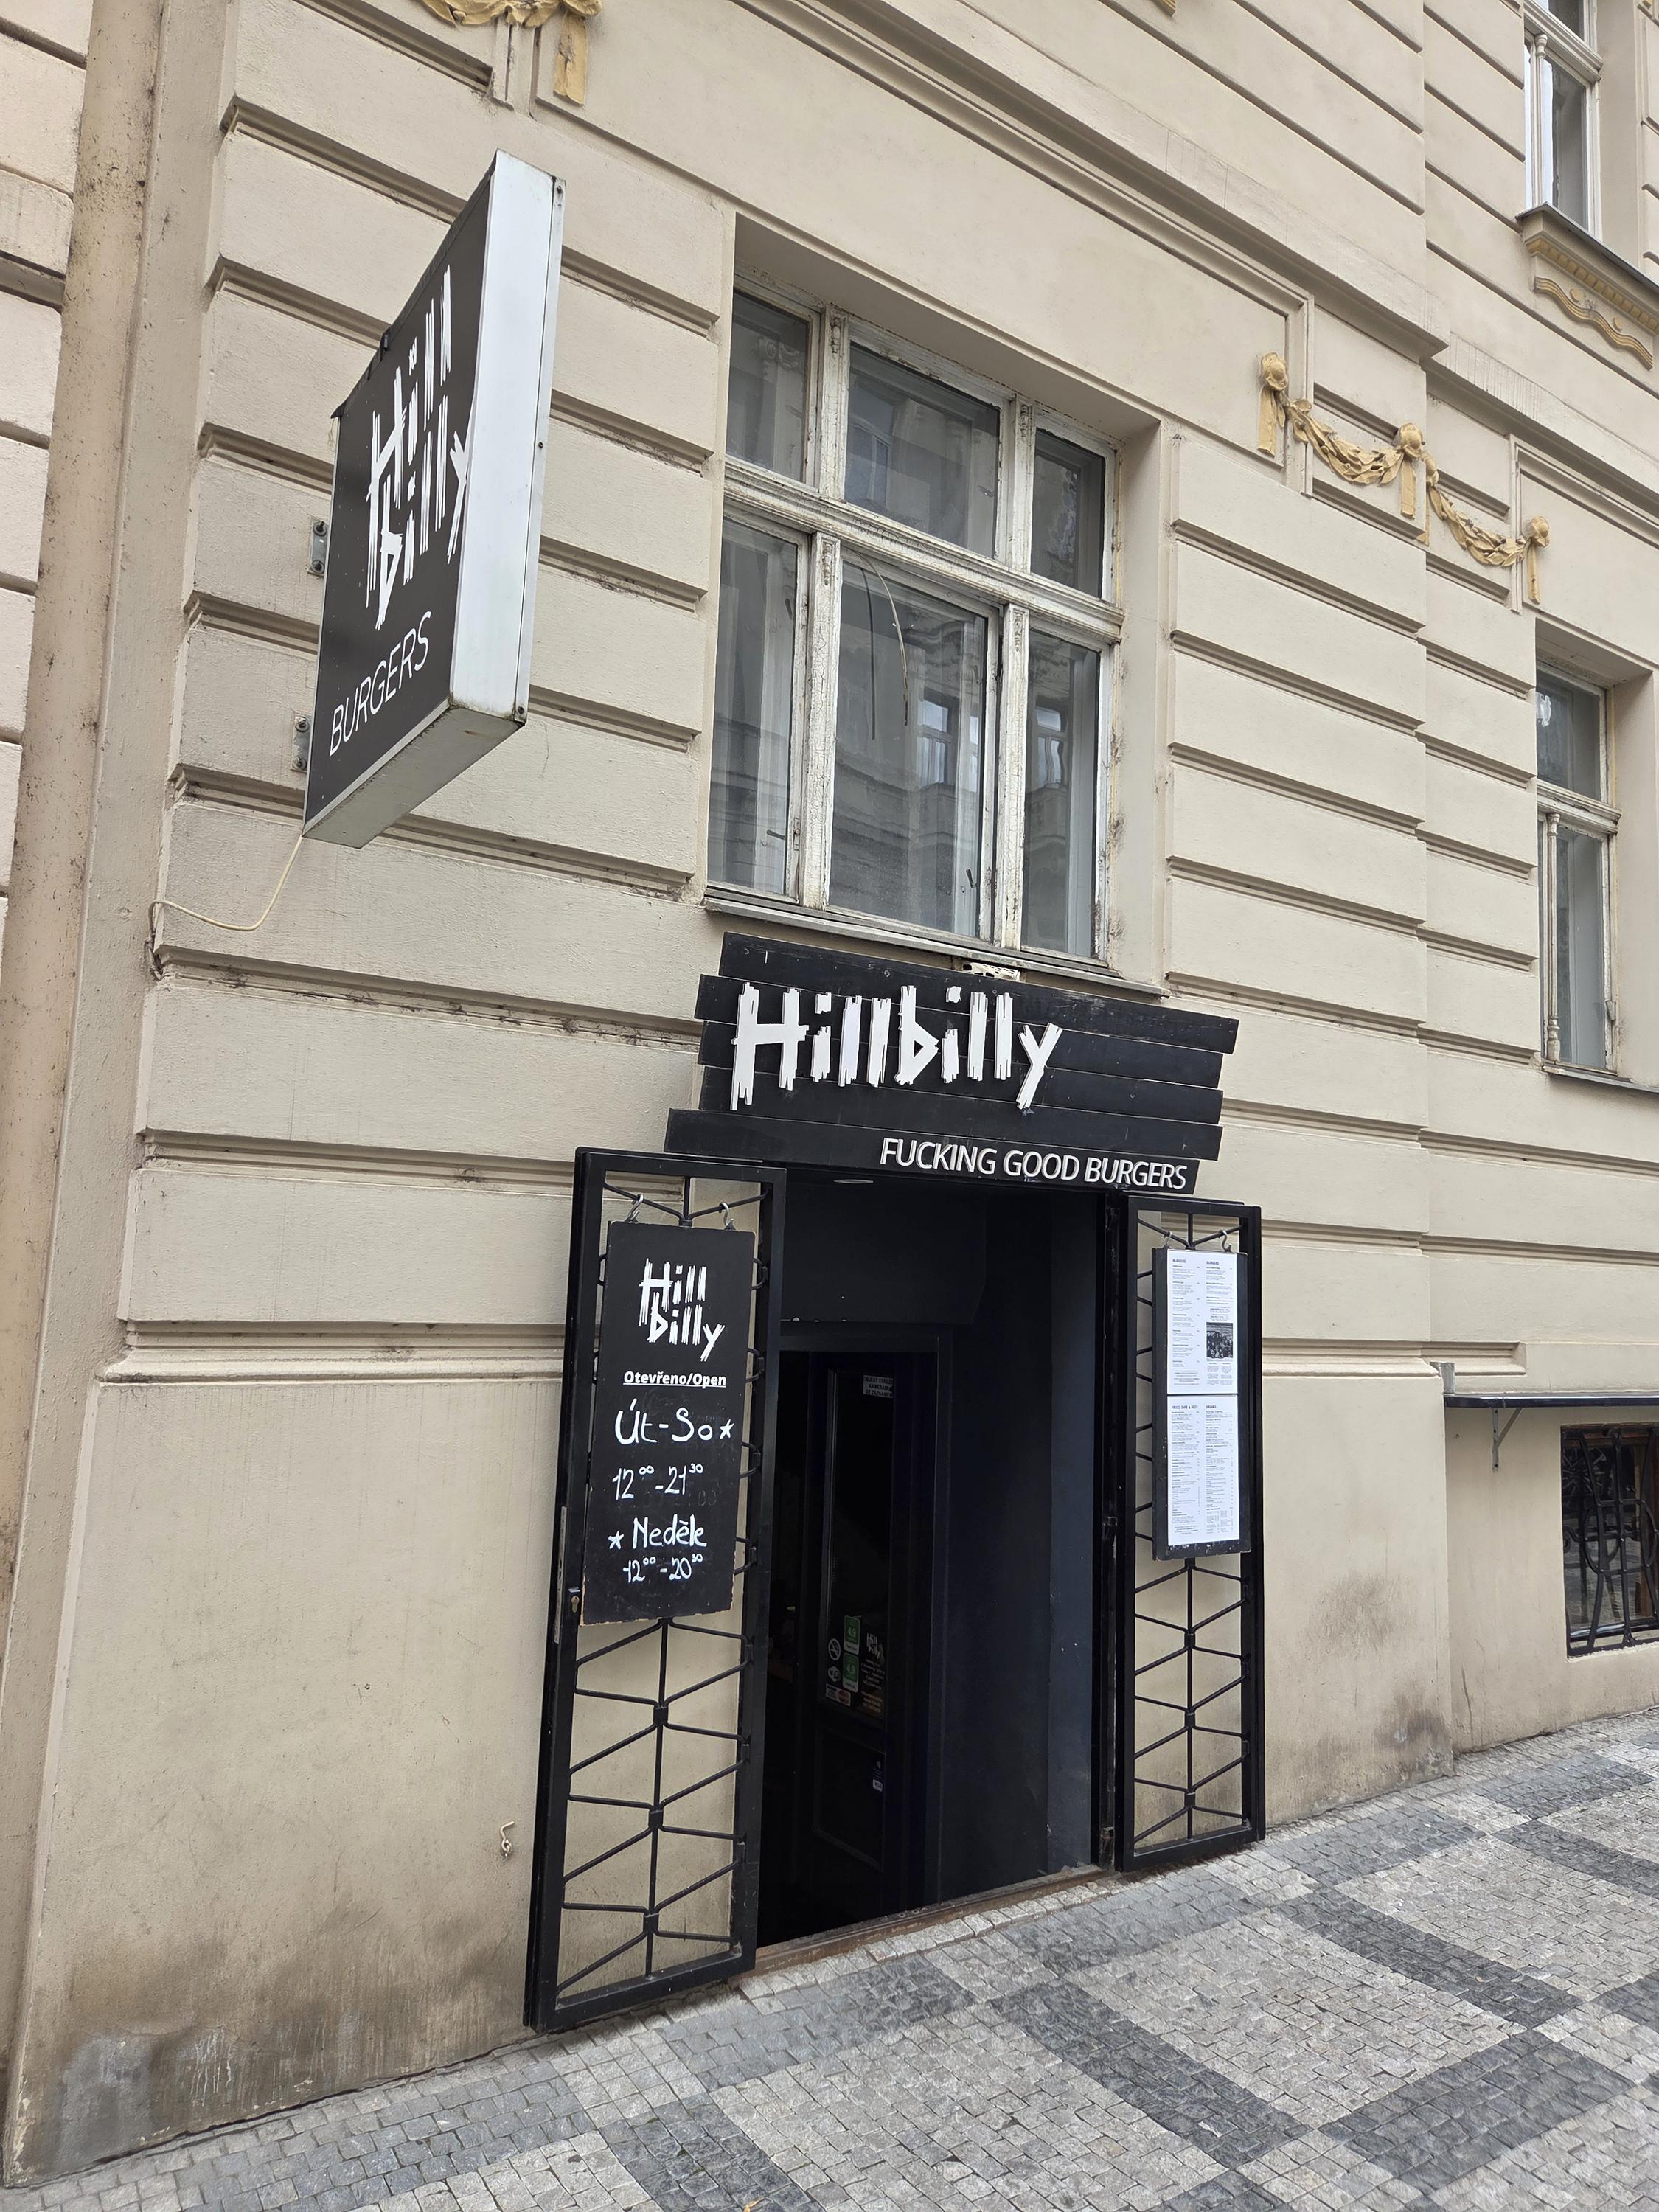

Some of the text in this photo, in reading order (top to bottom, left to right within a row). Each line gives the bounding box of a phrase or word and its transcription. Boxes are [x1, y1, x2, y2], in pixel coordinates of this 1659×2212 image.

[366, 264, 451, 608] Hill
[330, 611, 431, 757] BURGERS
[730, 982, 1063, 1110] Hillbilly
[880, 1138, 1188, 1189] FUCKING GOOD BURGERS
[639, 1258, 707, 1326] Hill
[647, 1292, 726, 1362] billy
[623, 1371, 726, 1389] Otevřeno/Open
[633, 1514, 707, 1549] Neděle
